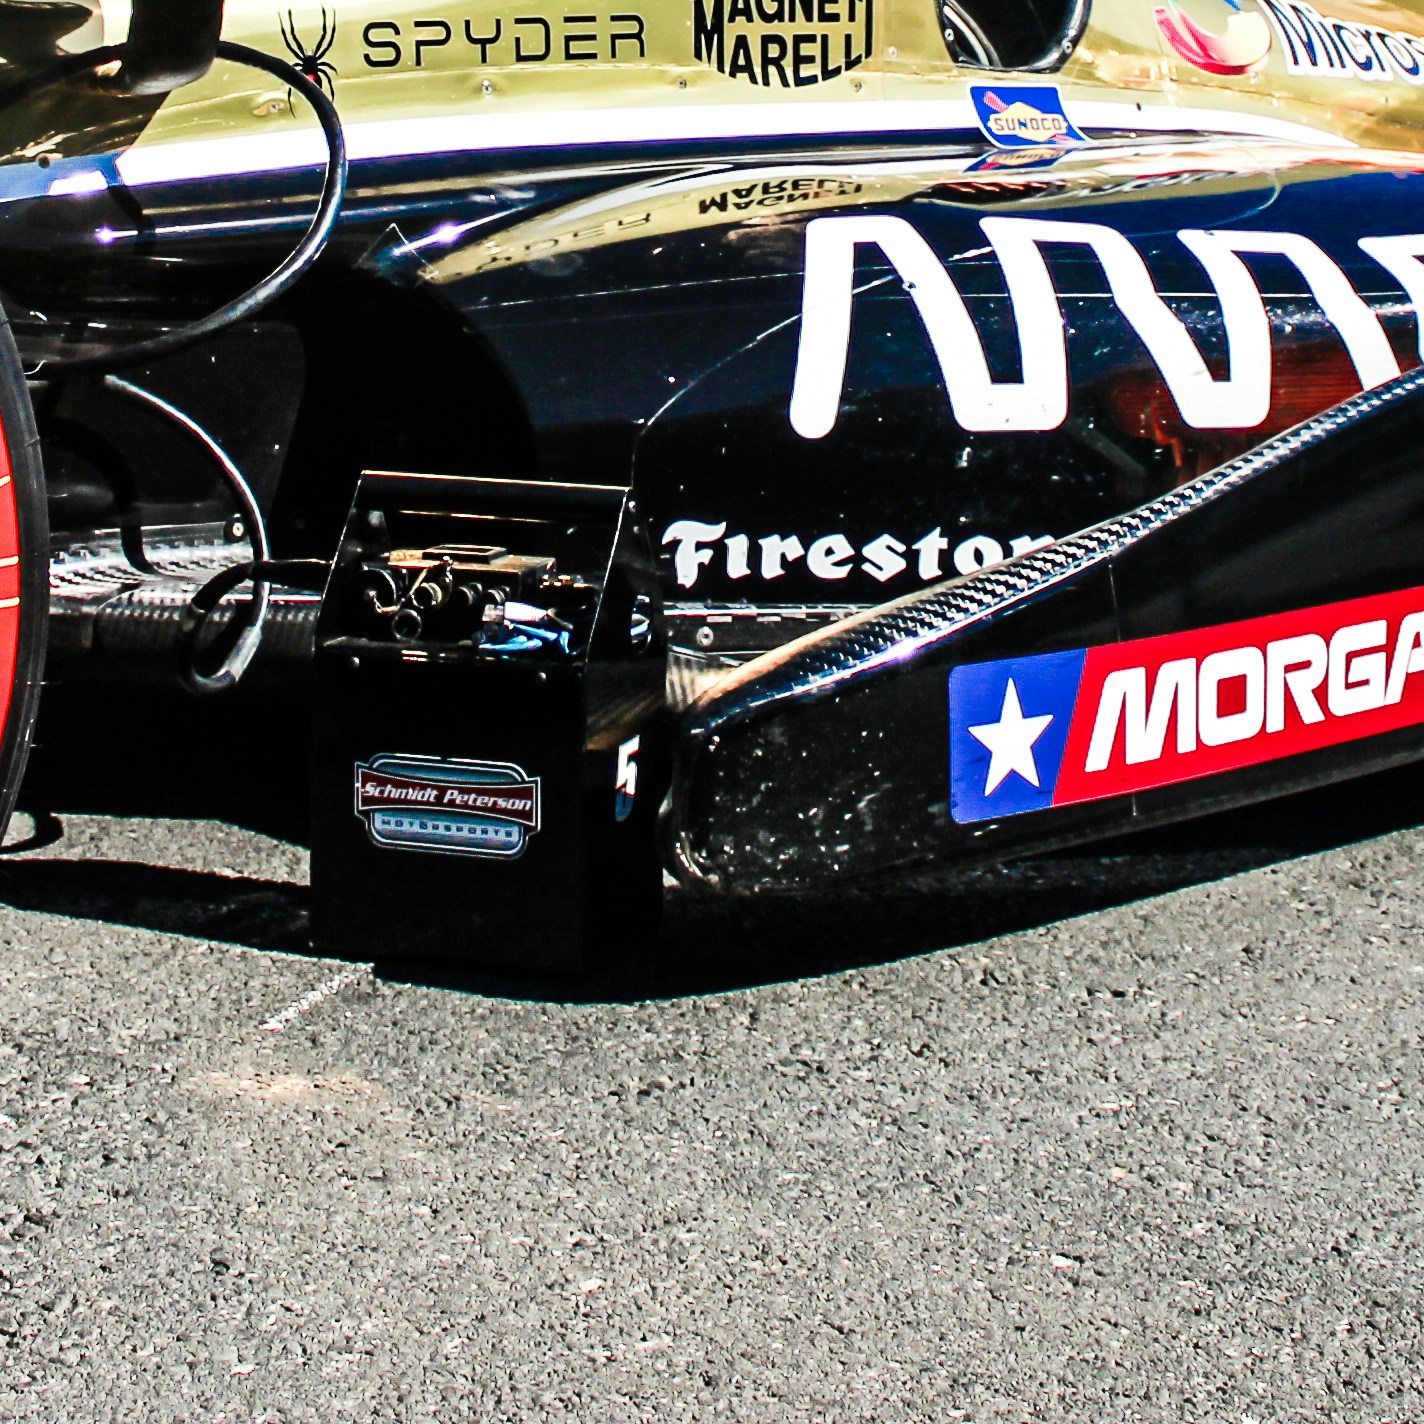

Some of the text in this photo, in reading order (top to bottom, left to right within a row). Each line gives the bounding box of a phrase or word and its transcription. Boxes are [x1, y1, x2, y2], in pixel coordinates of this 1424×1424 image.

[362, 13, 646, 68] SPYDER
[993, 115, 1066, 132] SUNOCO
[661, 519, 1058, 589] Firesto
[361, 781, 532, 812] Schmidt Peterson
[614, 733, 641, 822] 5
